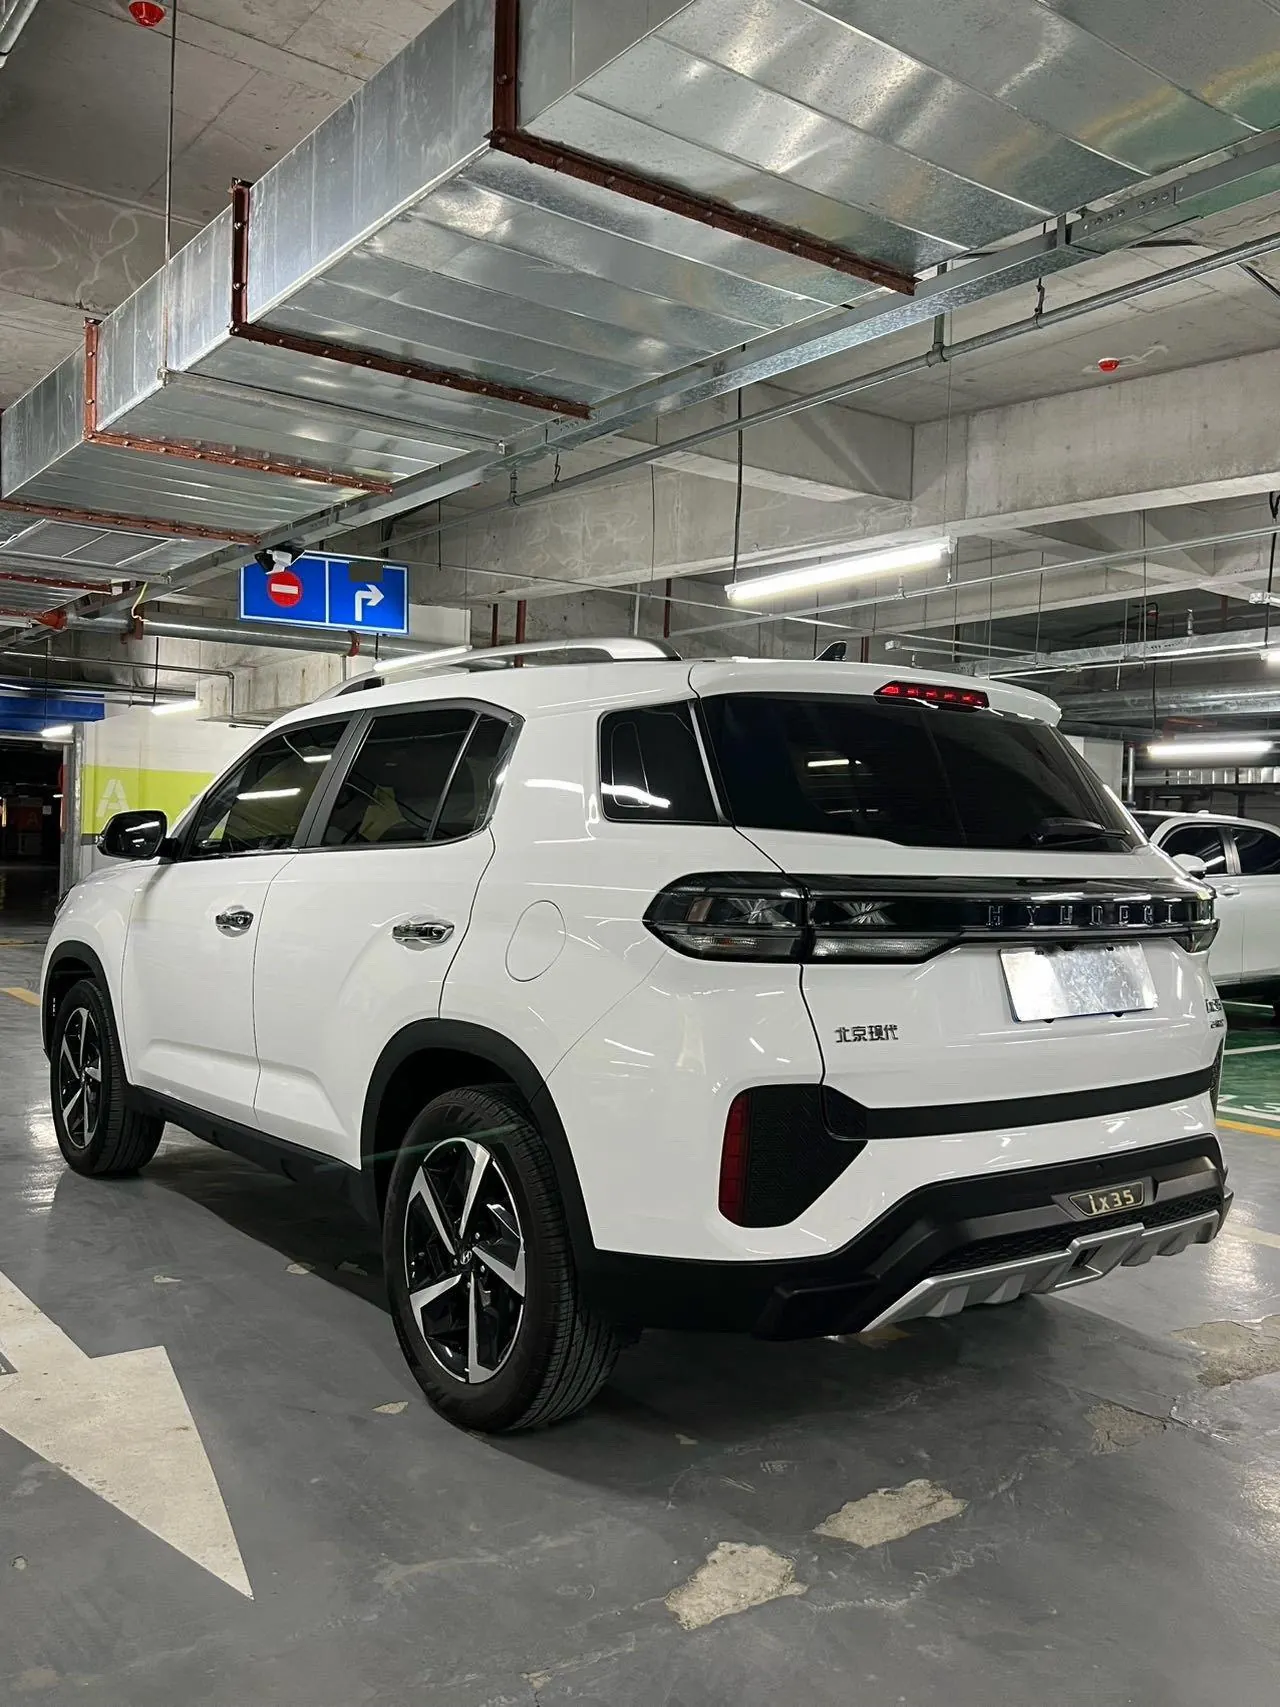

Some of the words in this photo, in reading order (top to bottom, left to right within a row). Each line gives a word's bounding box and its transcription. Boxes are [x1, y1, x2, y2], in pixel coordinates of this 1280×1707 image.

[96, 779, 129, 818] A
[986, 905, 1181, 926] HYUNDAI
[834, 1024, 898, 1043] 北京现代
[1088, 1189, 1134, 1213] ix35
